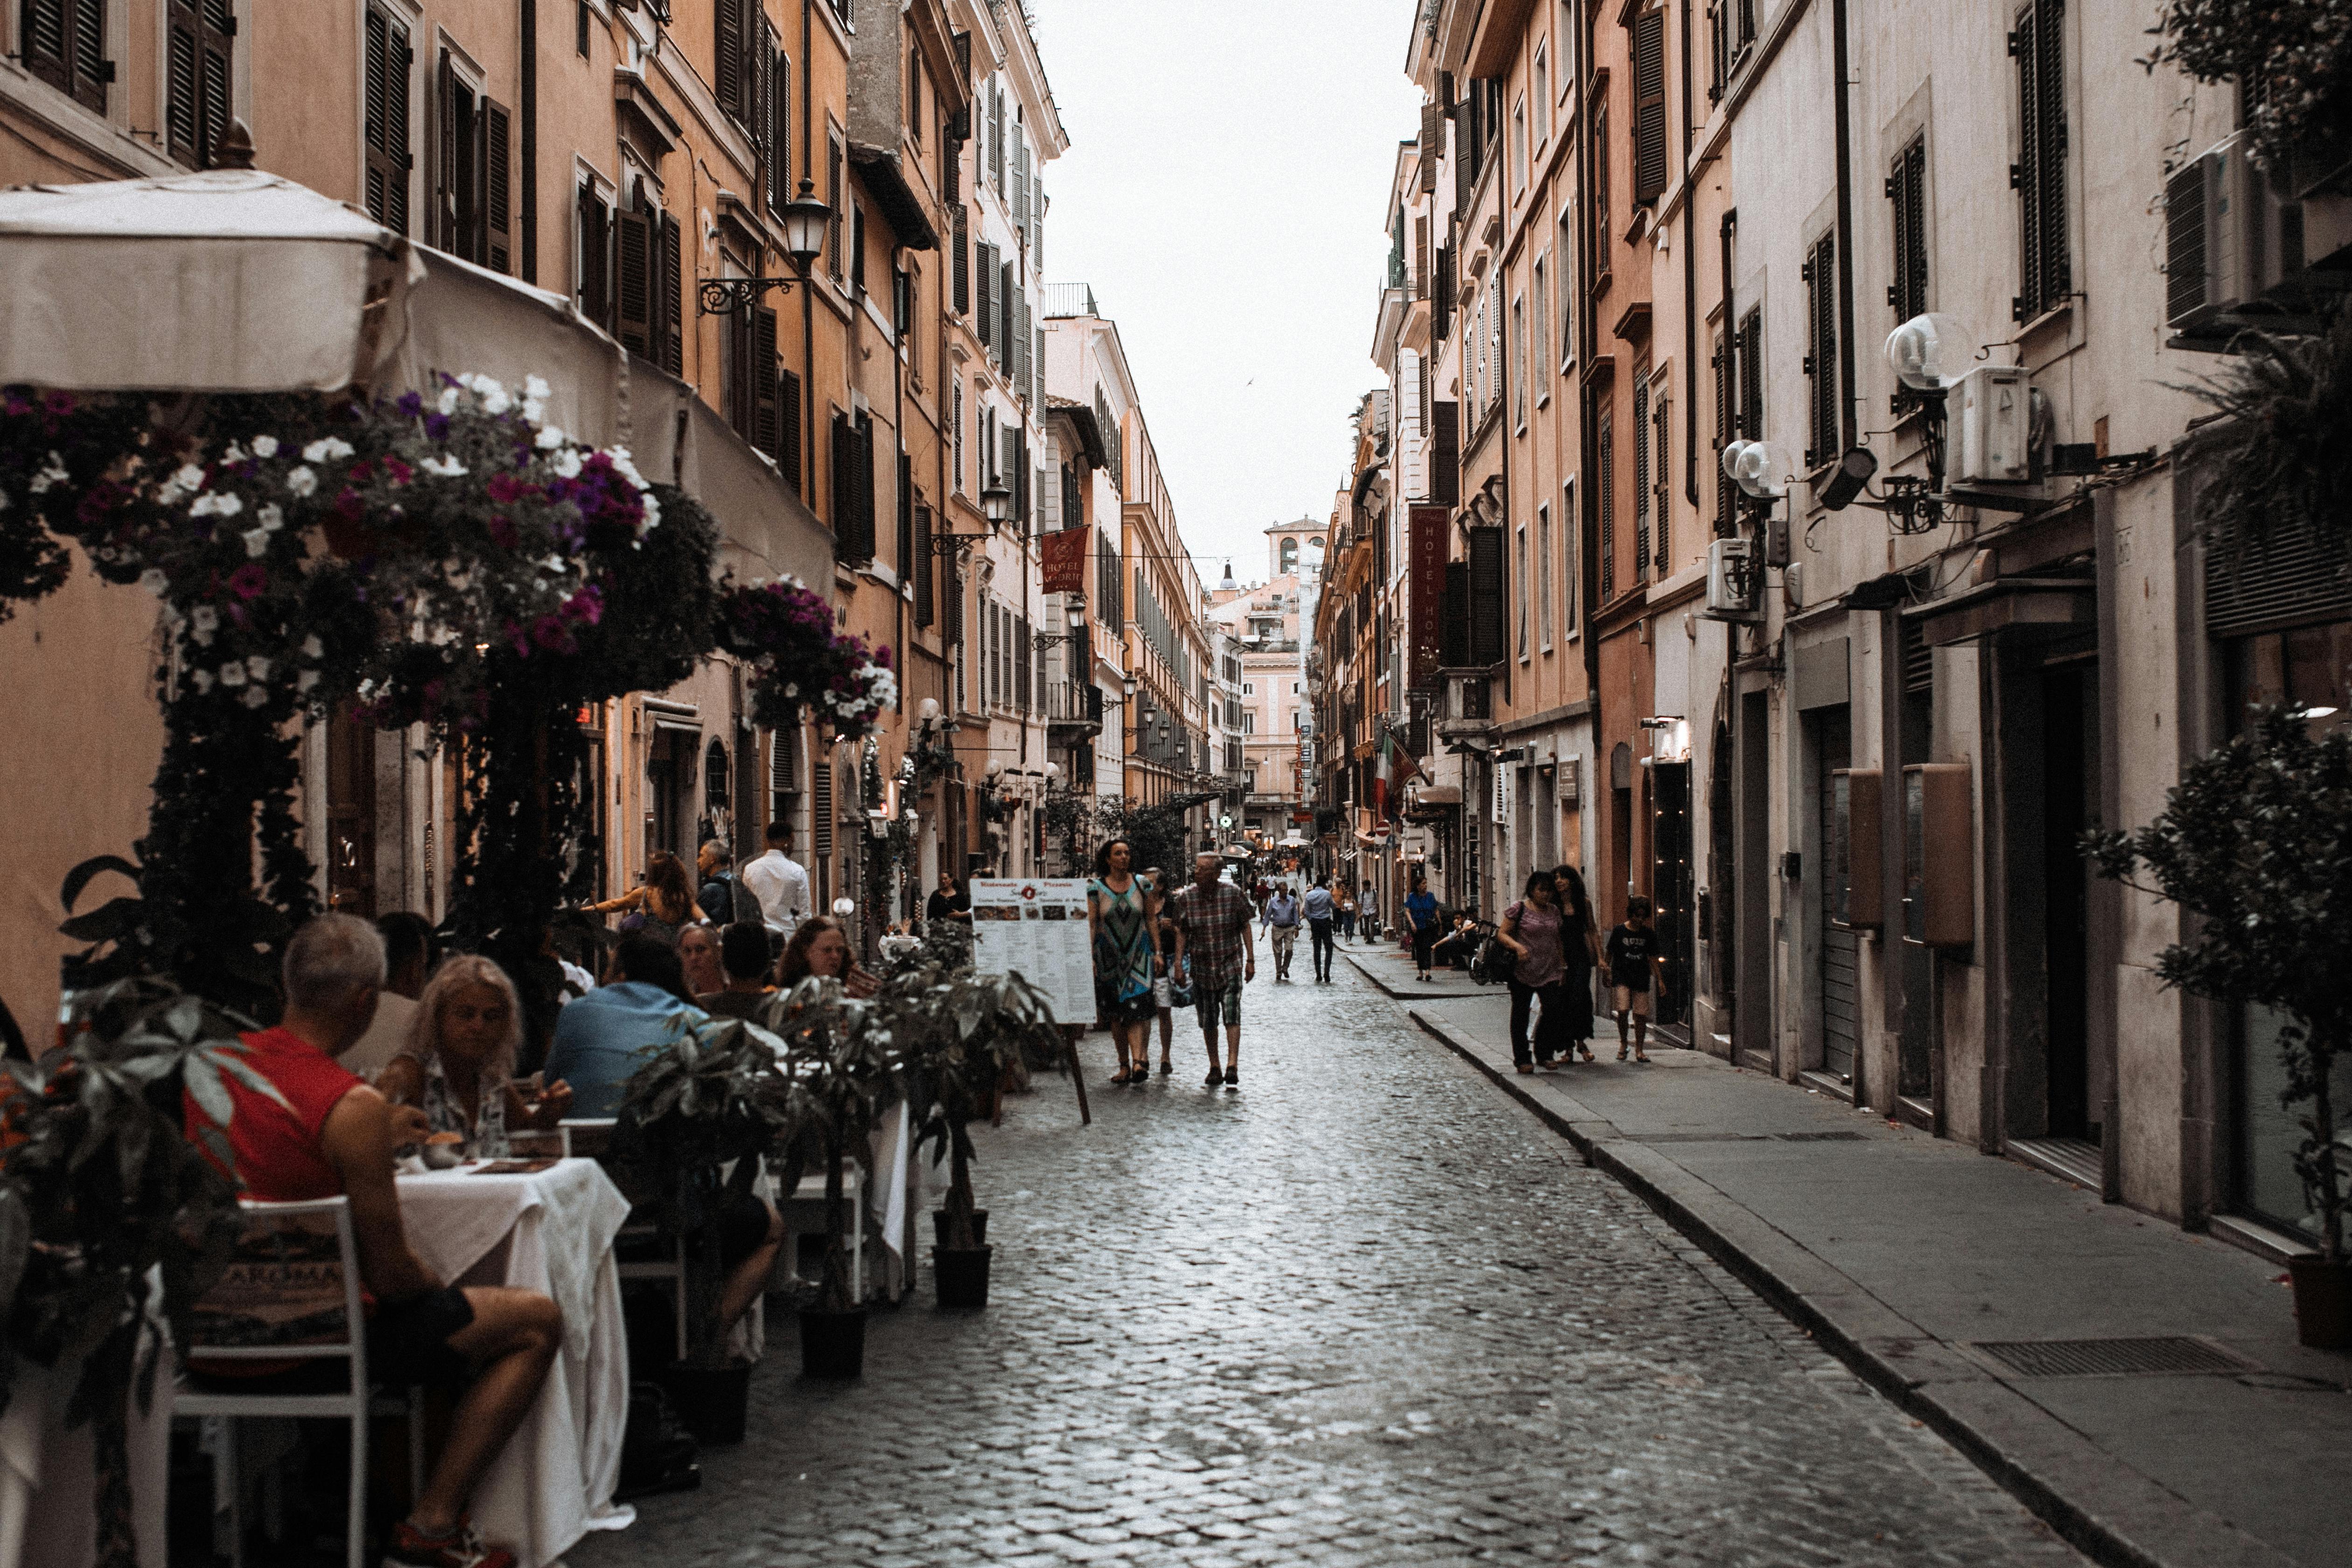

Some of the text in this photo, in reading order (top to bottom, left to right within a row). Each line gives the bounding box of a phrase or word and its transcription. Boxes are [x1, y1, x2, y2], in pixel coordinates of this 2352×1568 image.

[1044, 574, 1082, 582] MADRID
[1047, 562, 1077, 572] HOTEL
[1425, 606, 1434, 648] HOM
[1295, 728, 1303, 809] RISTORANTE
